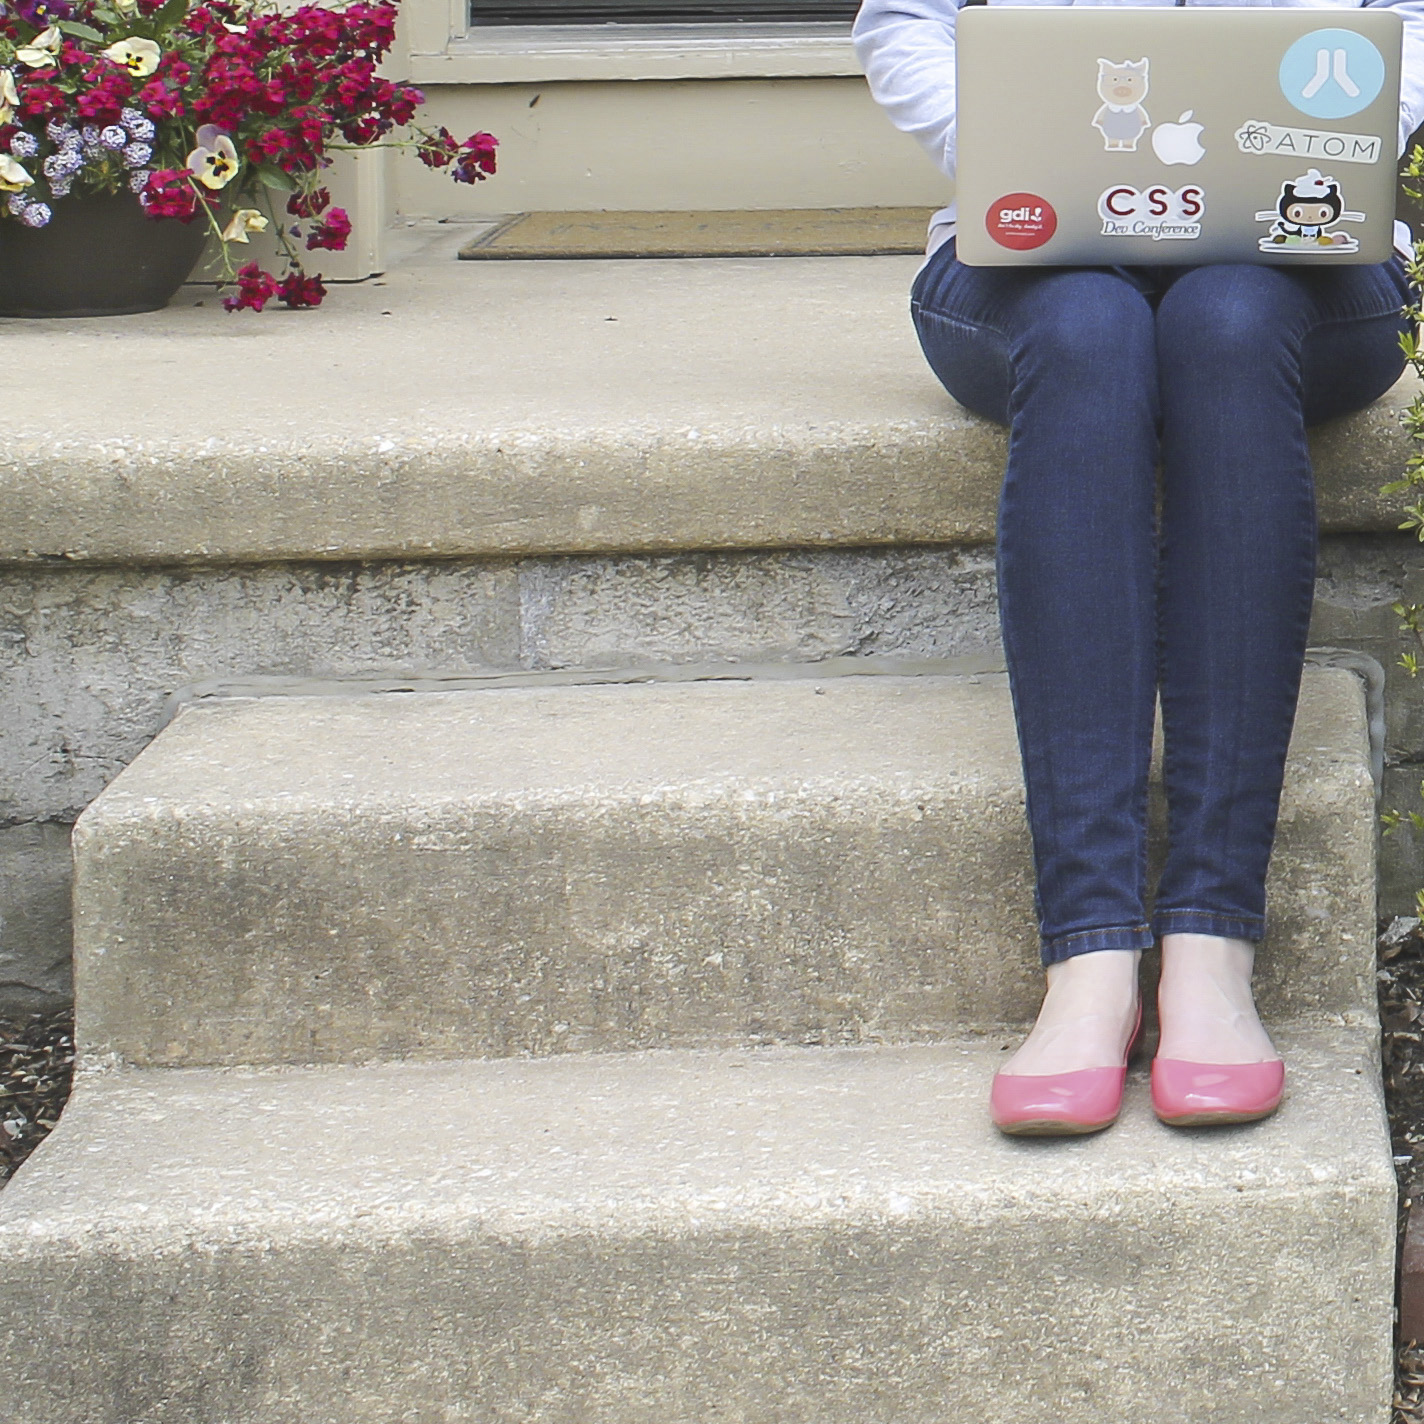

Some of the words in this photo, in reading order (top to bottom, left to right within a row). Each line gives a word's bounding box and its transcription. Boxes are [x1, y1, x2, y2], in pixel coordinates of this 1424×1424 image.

[1275, 132, 1376, 159] ATOM
[1106, 188, 1200, 216] CSS
[1104, 220, 1128, 234] Dev
[1132, 220, 1198, 239] Conference
